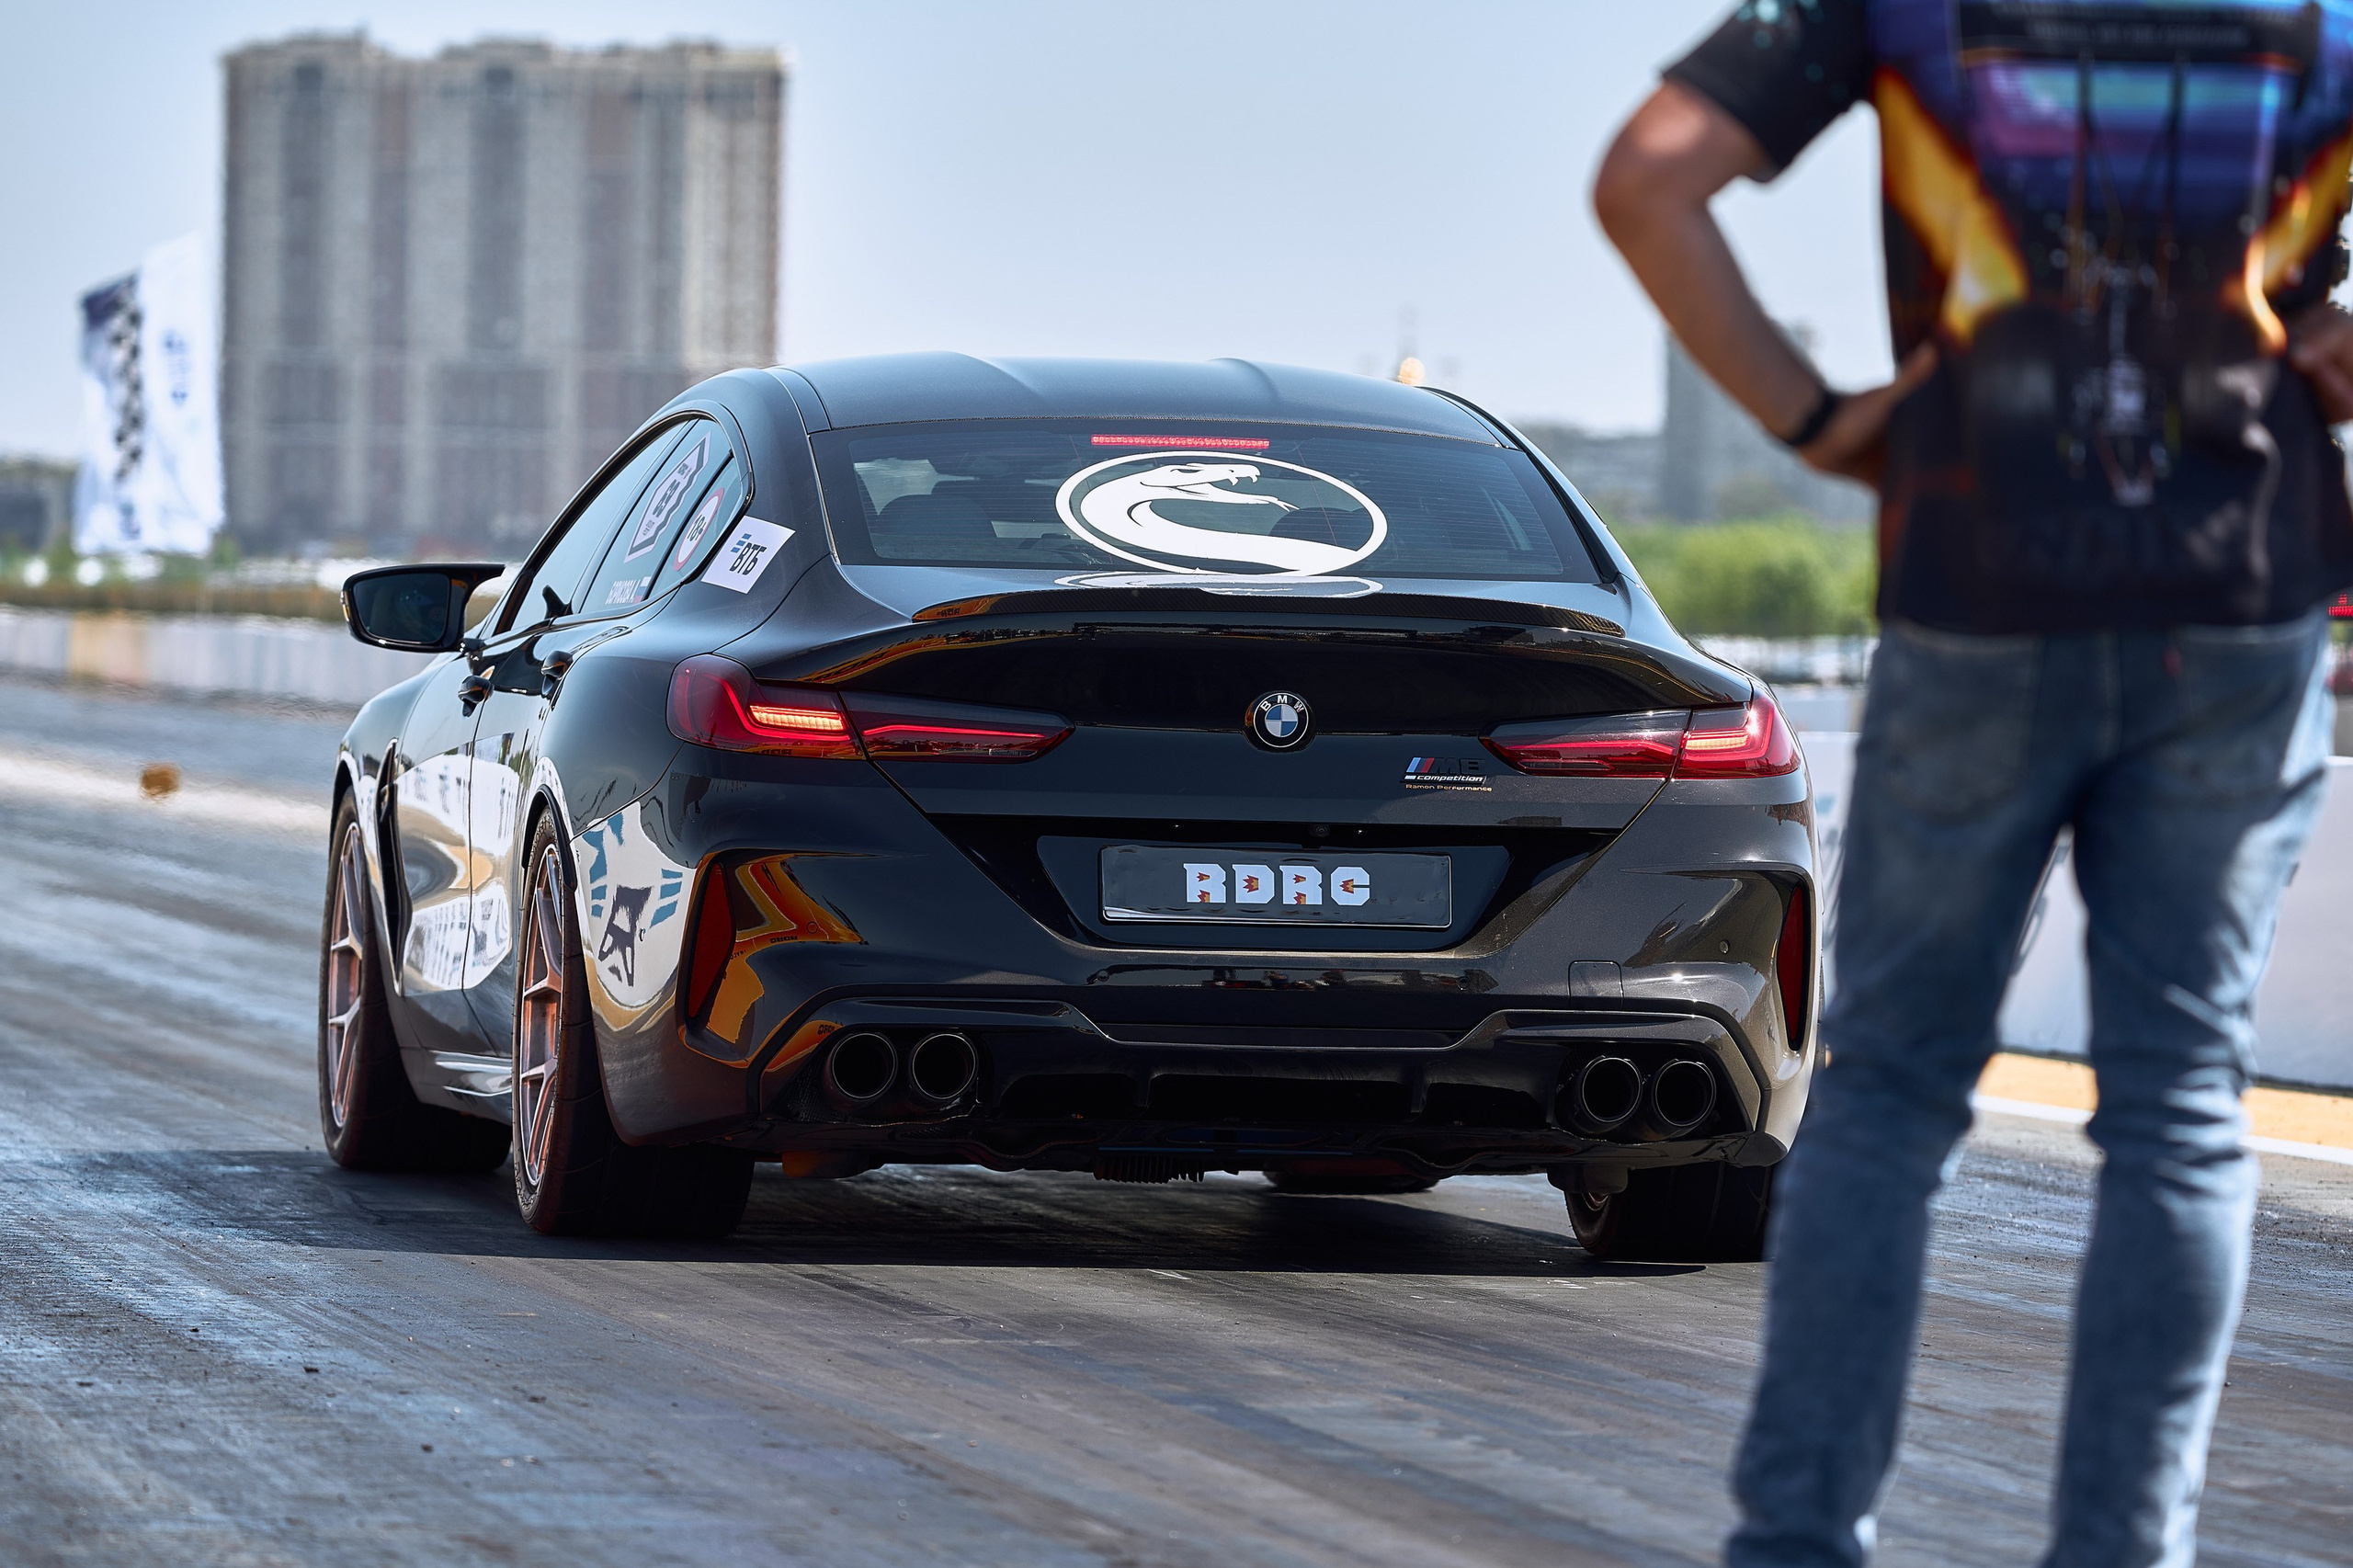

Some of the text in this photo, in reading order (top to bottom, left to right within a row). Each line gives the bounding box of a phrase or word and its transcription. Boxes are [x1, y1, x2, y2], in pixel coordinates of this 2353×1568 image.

[687, 514, 707, 542] 18+
[729, 541, 767, 576] ВТБ
[1260, 695, 1304, 713] BMW
[1183, 863, 1370, 906] RDRC
